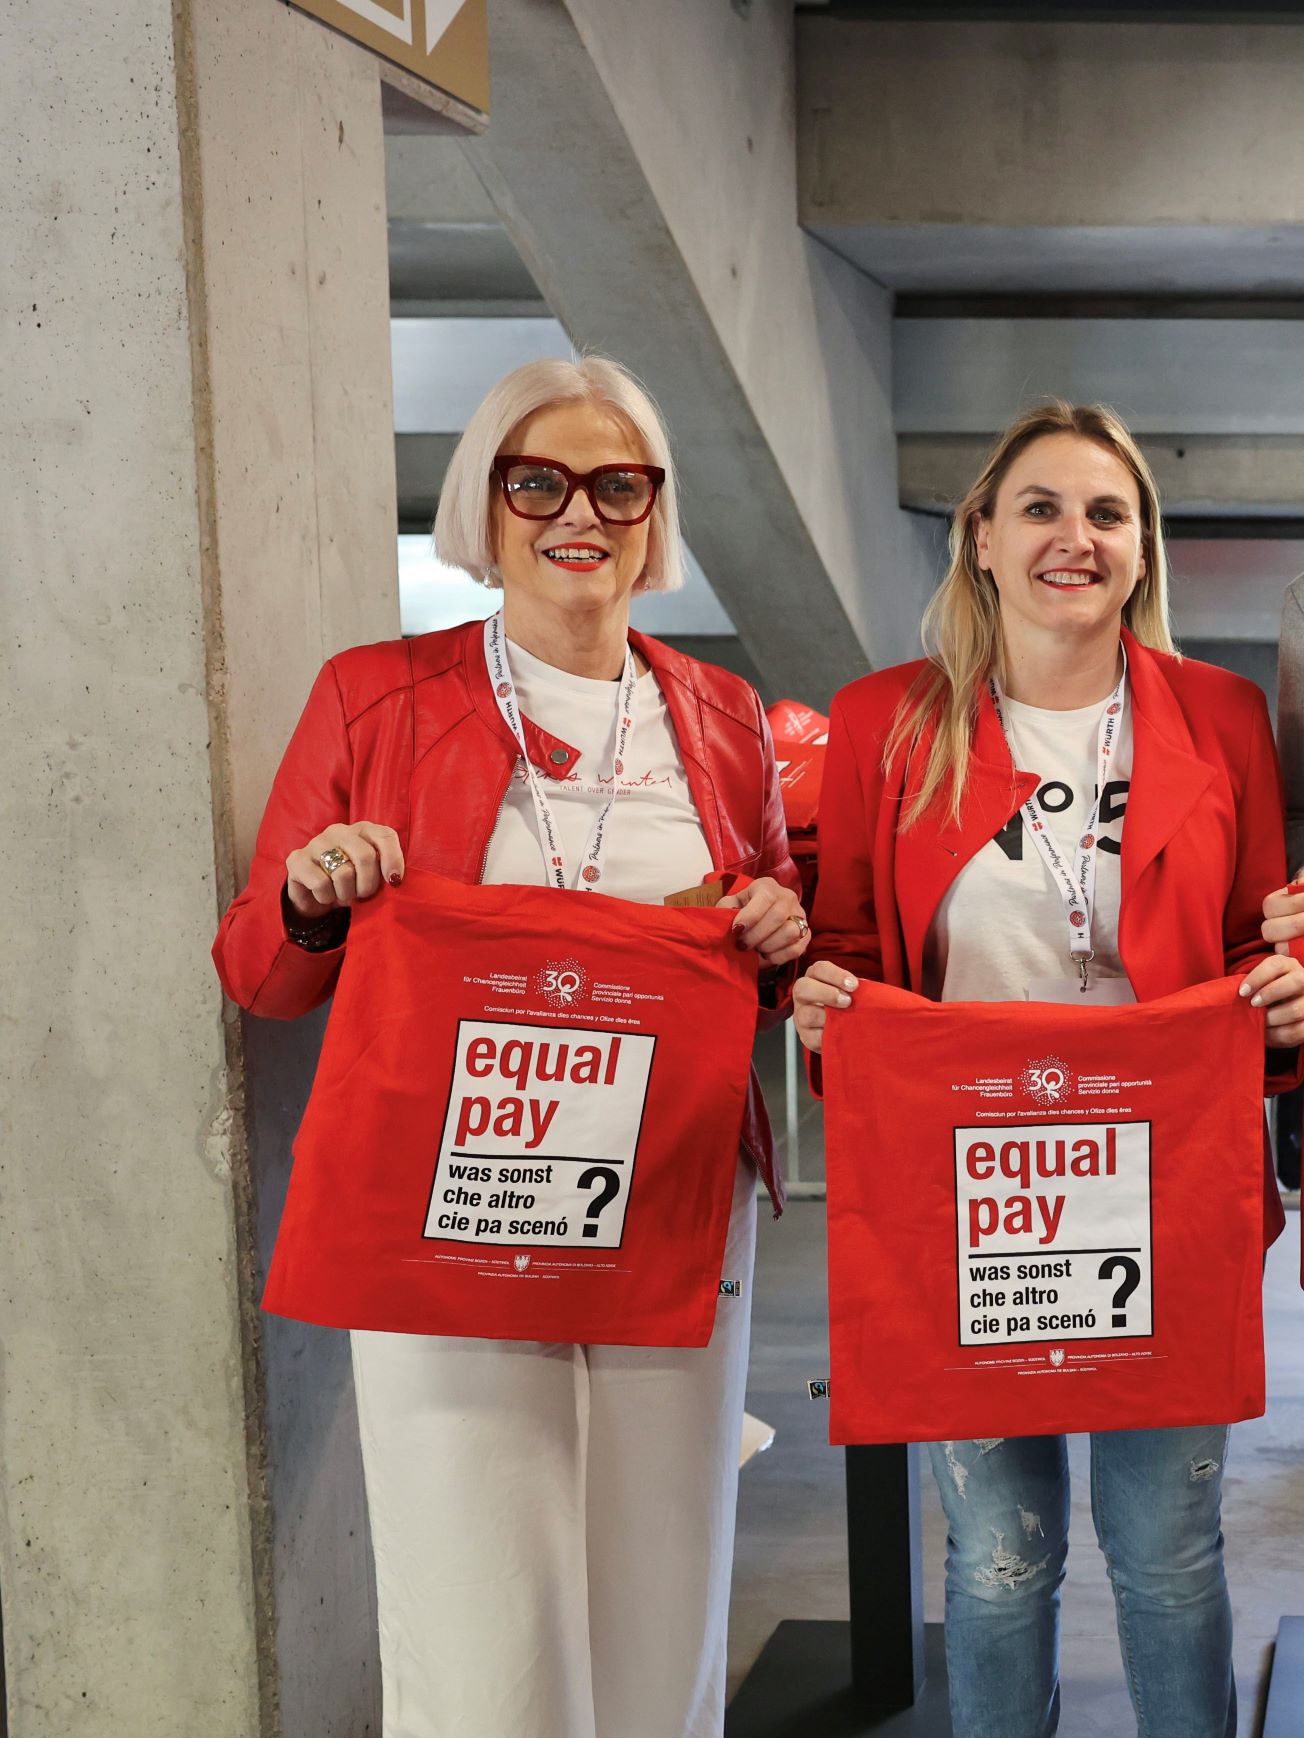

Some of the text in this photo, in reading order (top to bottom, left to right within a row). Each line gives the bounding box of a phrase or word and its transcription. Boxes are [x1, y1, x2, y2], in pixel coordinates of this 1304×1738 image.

[489, 972, 528, 981] Landesbeirat
[593, 982, 630, 991] Commissione
[492, 986, 526, 995] Frauenbüro
[591, 995, 613, 1003] Servizio
[592, 989, 621, 997] provinciale
[634, 993, 664, 1001] opportunità
[484, 1005, 515, 1013] Comisciun
[570, 1013, 594, 1021] chances
[465, 1036, 622, 1091] equal
[960, 1084, 1013, 1092] Chancengleichheit
[1121, 1079, 1152, 1088] opportunità
[454, 1096, 560, 1149] pay
[966, 1128, 1116, 1189] equal
[448, 1164, 552, 1184] was sonst
[443, 1187, 535, 1210] che altro
[576, 1166, 621, 1238] ?
[438, 1211, 568, 1236] cie pa scenó
[968, 1195, 1066, 1248] pay
[970, 1259, 1072, 1282] was sonst
[970, 1287, 1058, 1308] che altro
[1098, 1255, 1141, 1328] ?
[970, 1308, 1096, 1336] cie pa scenó
